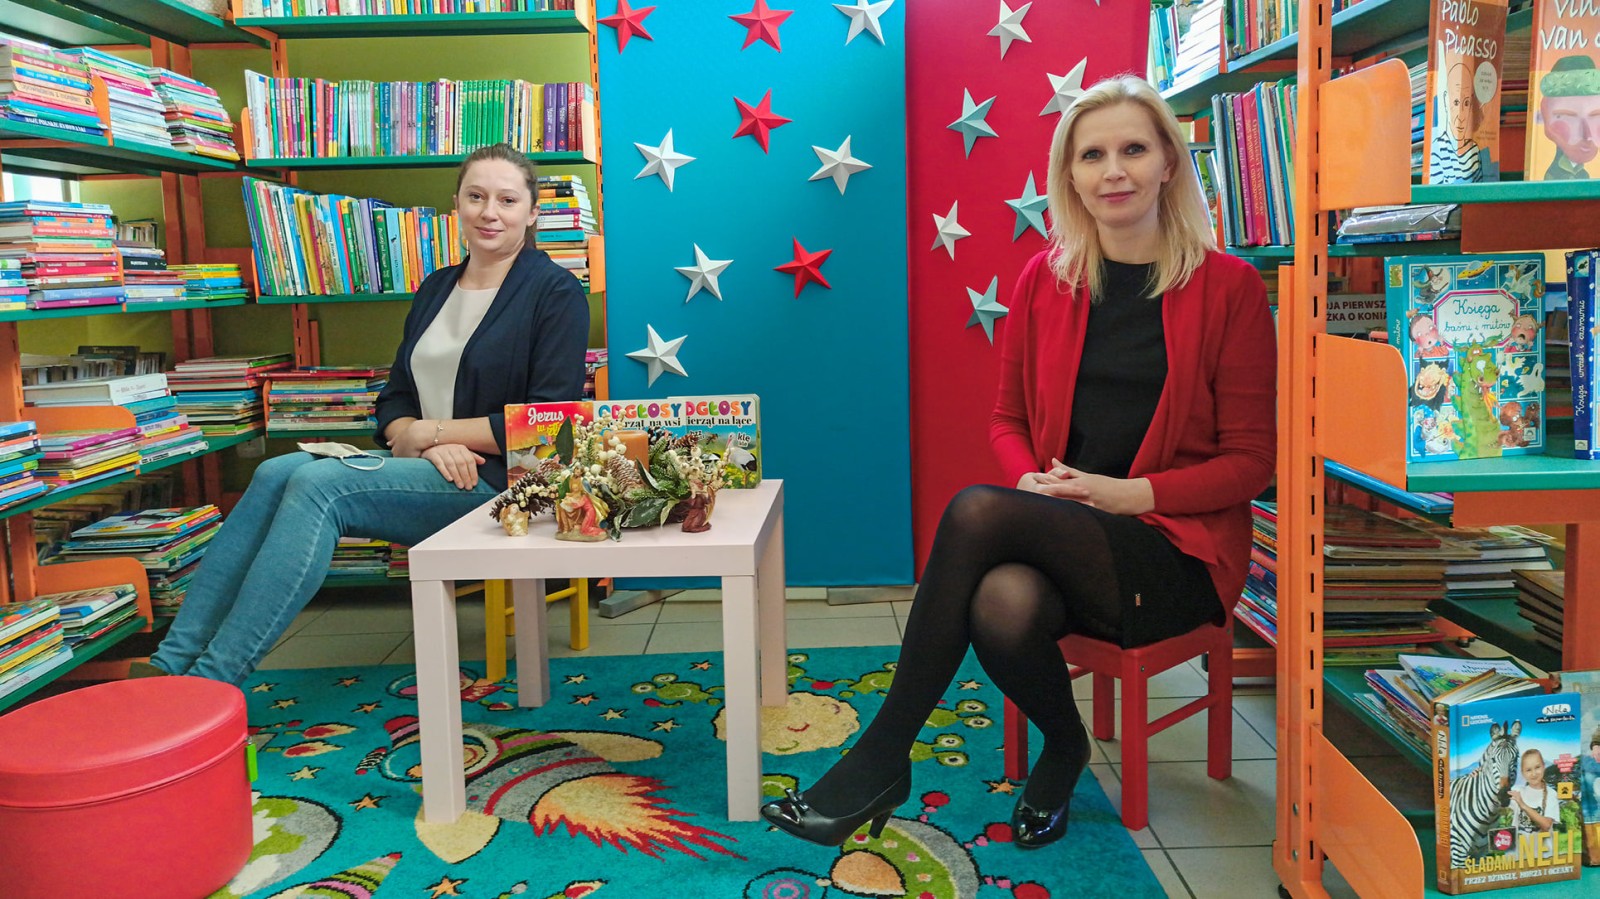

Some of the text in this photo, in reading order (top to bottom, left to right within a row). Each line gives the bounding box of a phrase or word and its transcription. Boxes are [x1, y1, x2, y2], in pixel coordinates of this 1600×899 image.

[1442, 0, 1479, 26] Pablo
[1554, 0, 1600, 18] Vin
[1445, 26, 1497, 60] Picasso
[1540, 25, 1589, 50] van
[1348, 312, 1356, 321] O
[1453, 299, 1500, 319] Księga
[1444, 321, 1472, 331] baśni
[1482, 318, 1511, 330] mitów
[1578, 300, 1586, 341] czarownic
[1575, 384, 1588, 417] Księga
[528, 407, 564, 425] Jezus
[598, 402, 682, 419] ODGŁOSY
[650, 420, 663, 428] na
[664, 417, 681, 427] wsi
[718, 418, 732, 426] na
[1465, 855, 1516, 875] ŚLADAMI
[1518, 830, 1574, 869] NELI
